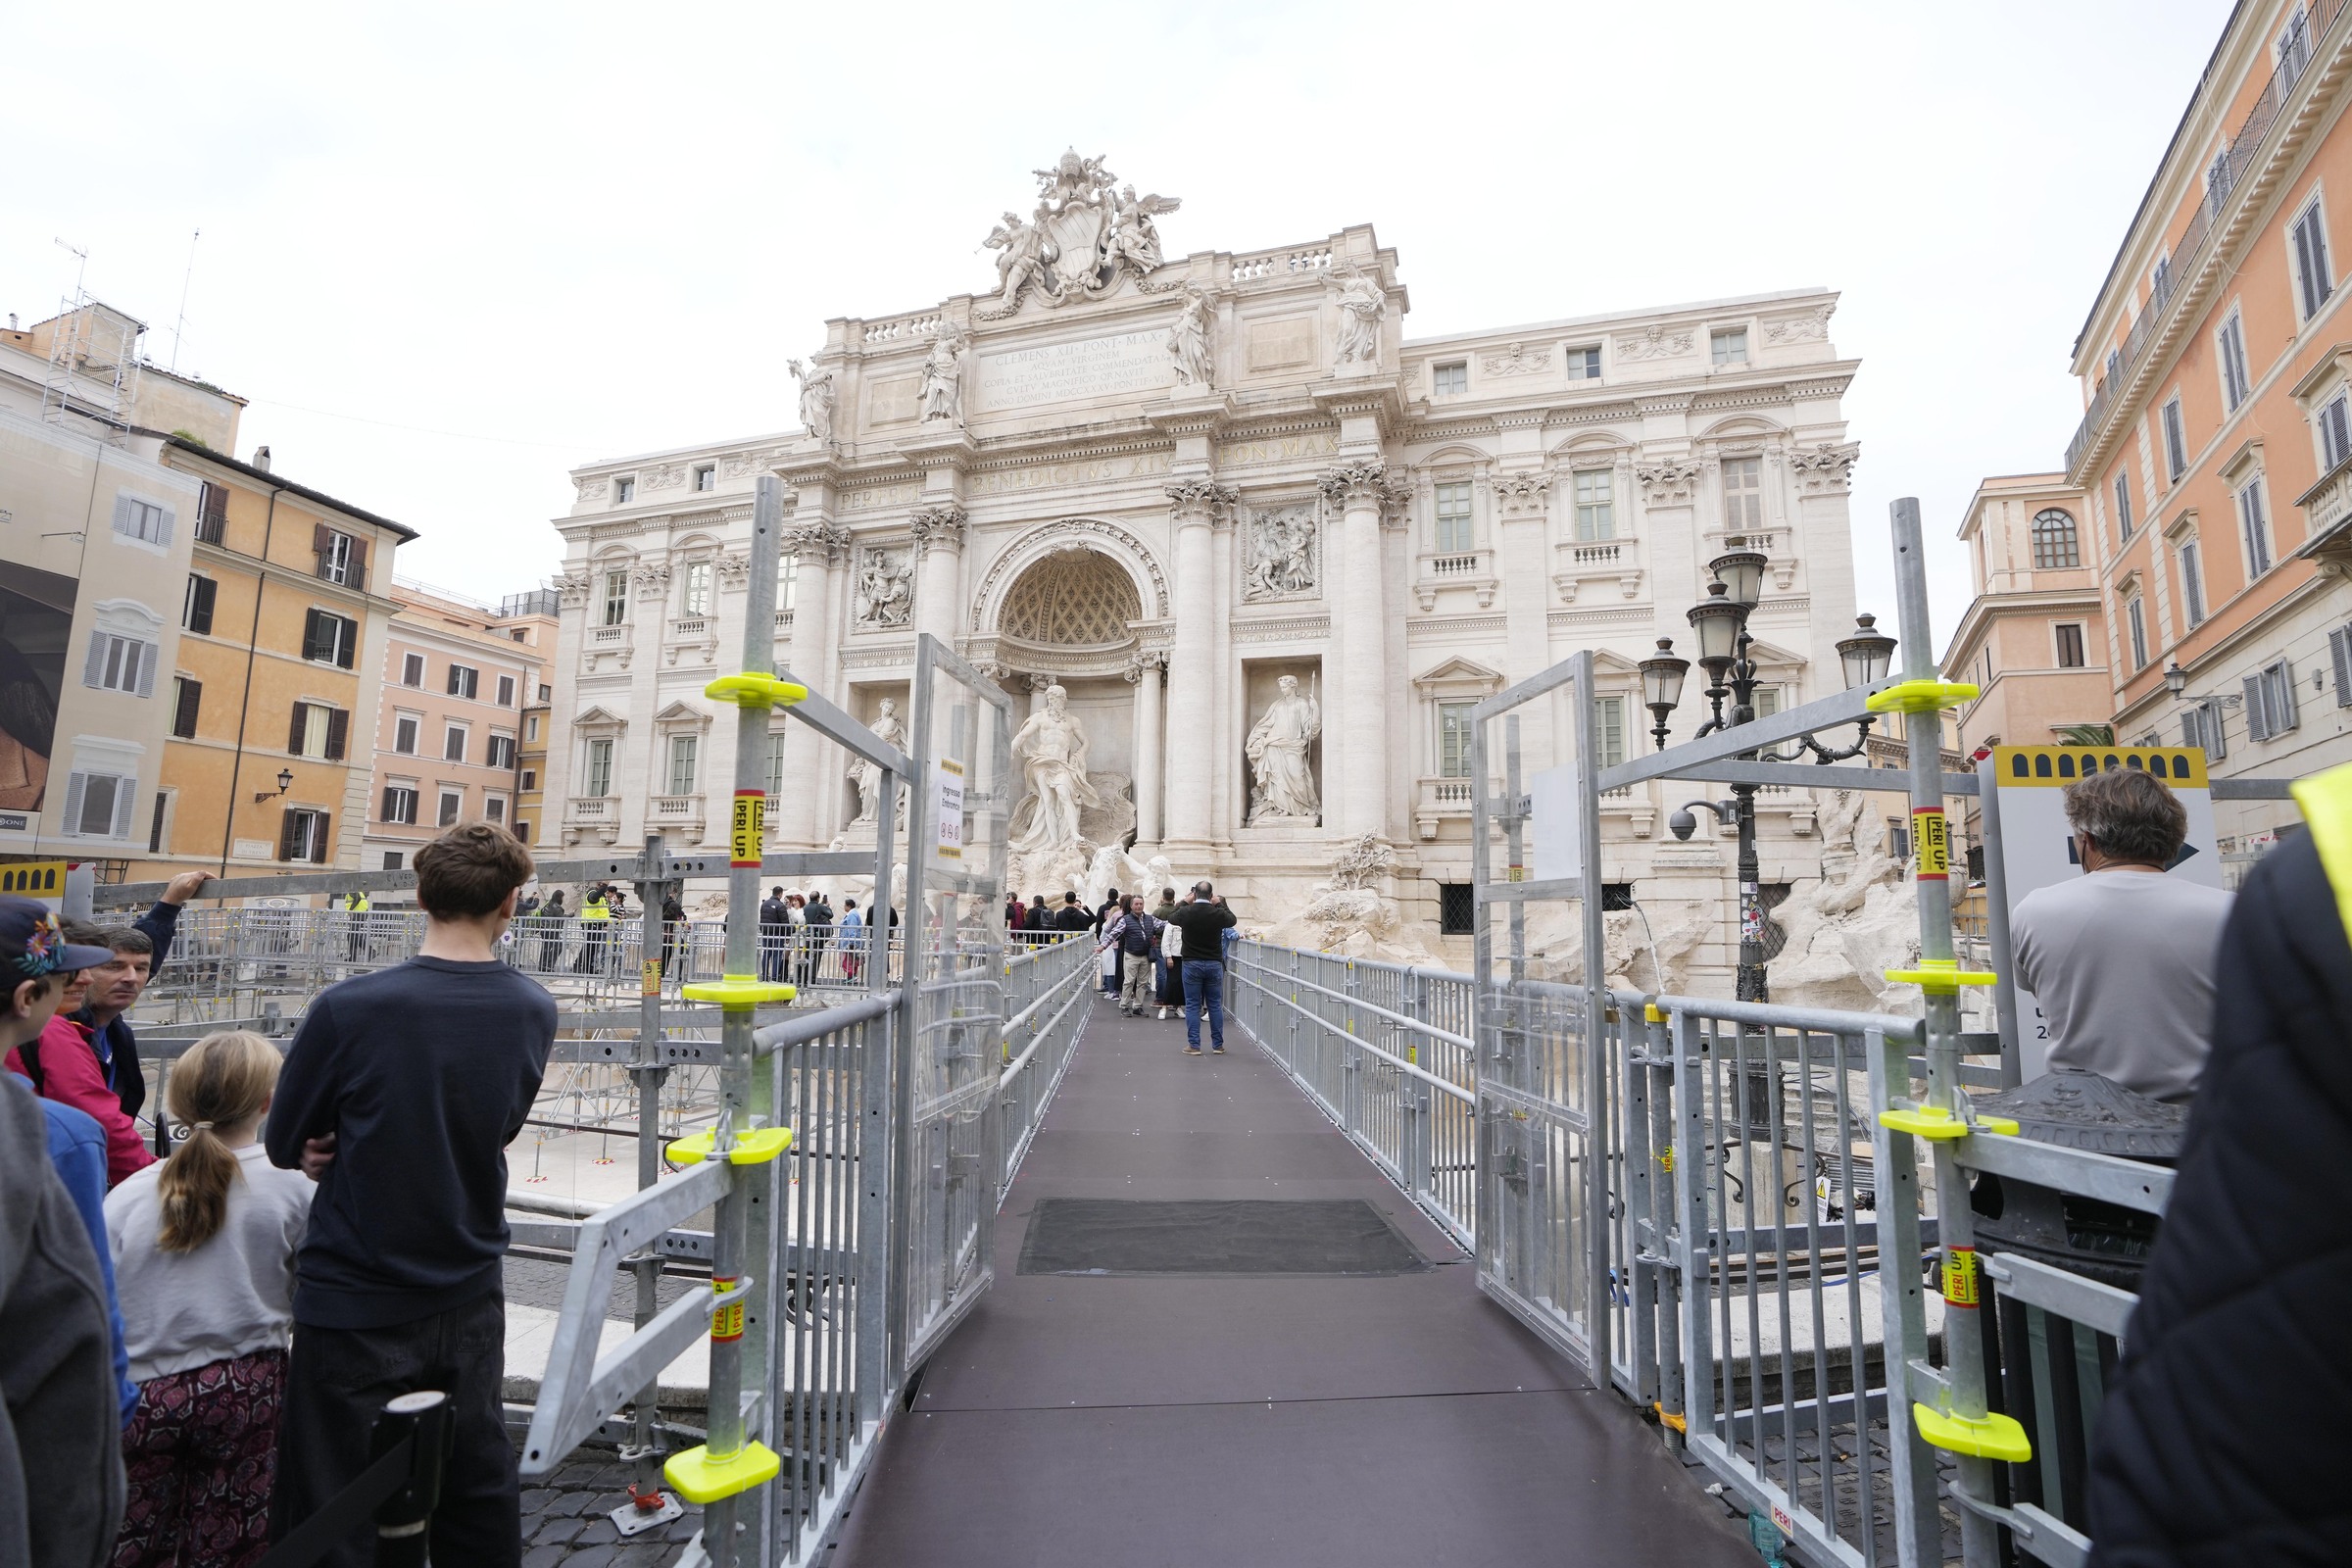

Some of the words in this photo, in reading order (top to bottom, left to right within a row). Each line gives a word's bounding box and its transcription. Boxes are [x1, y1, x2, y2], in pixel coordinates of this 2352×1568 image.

[995, 350, 1050, 367] CLEMENS
[1030, 359, 1065, 371] AQVAM
[1071, 351, 1119, 365] VIRGINEM
[984, 377, 1010, 388] COPIA
[1014, 374, 1026, 383] ET
[1028, 366, 1088, 382] SALVBRITATE
[1042, 374, 1097, 390] MAGNIFICO
[1100, 368, 1145, 381] ORNAVIT
[987, 397, 1014, 408] ANNO
[1017, 392, 1052, 404] DOMINI
[972, 461, 1112, 493] BENEDICTVS
[1281, 434, 1339, 459] MAX
[943, 784, 960, 798] Ingresso
[941, 798, 960, 811] Entrance
[735, 805, 747, 830] PERI
[1932, 821, 1943, 845] PERI
[734, 835, 746, 858] UP
[1934, 850, 1945, 870] UP
[646, 962, 652, 973] UP
[1951, 1251, 1962, 1270] UP
[1952, 1273, 1965, 1298] PERI
[714, 1307, 724, 1330] PER
[733, 1303, 743, 1328] PERI
[1775, 1506, 1791, 1531] PERI
